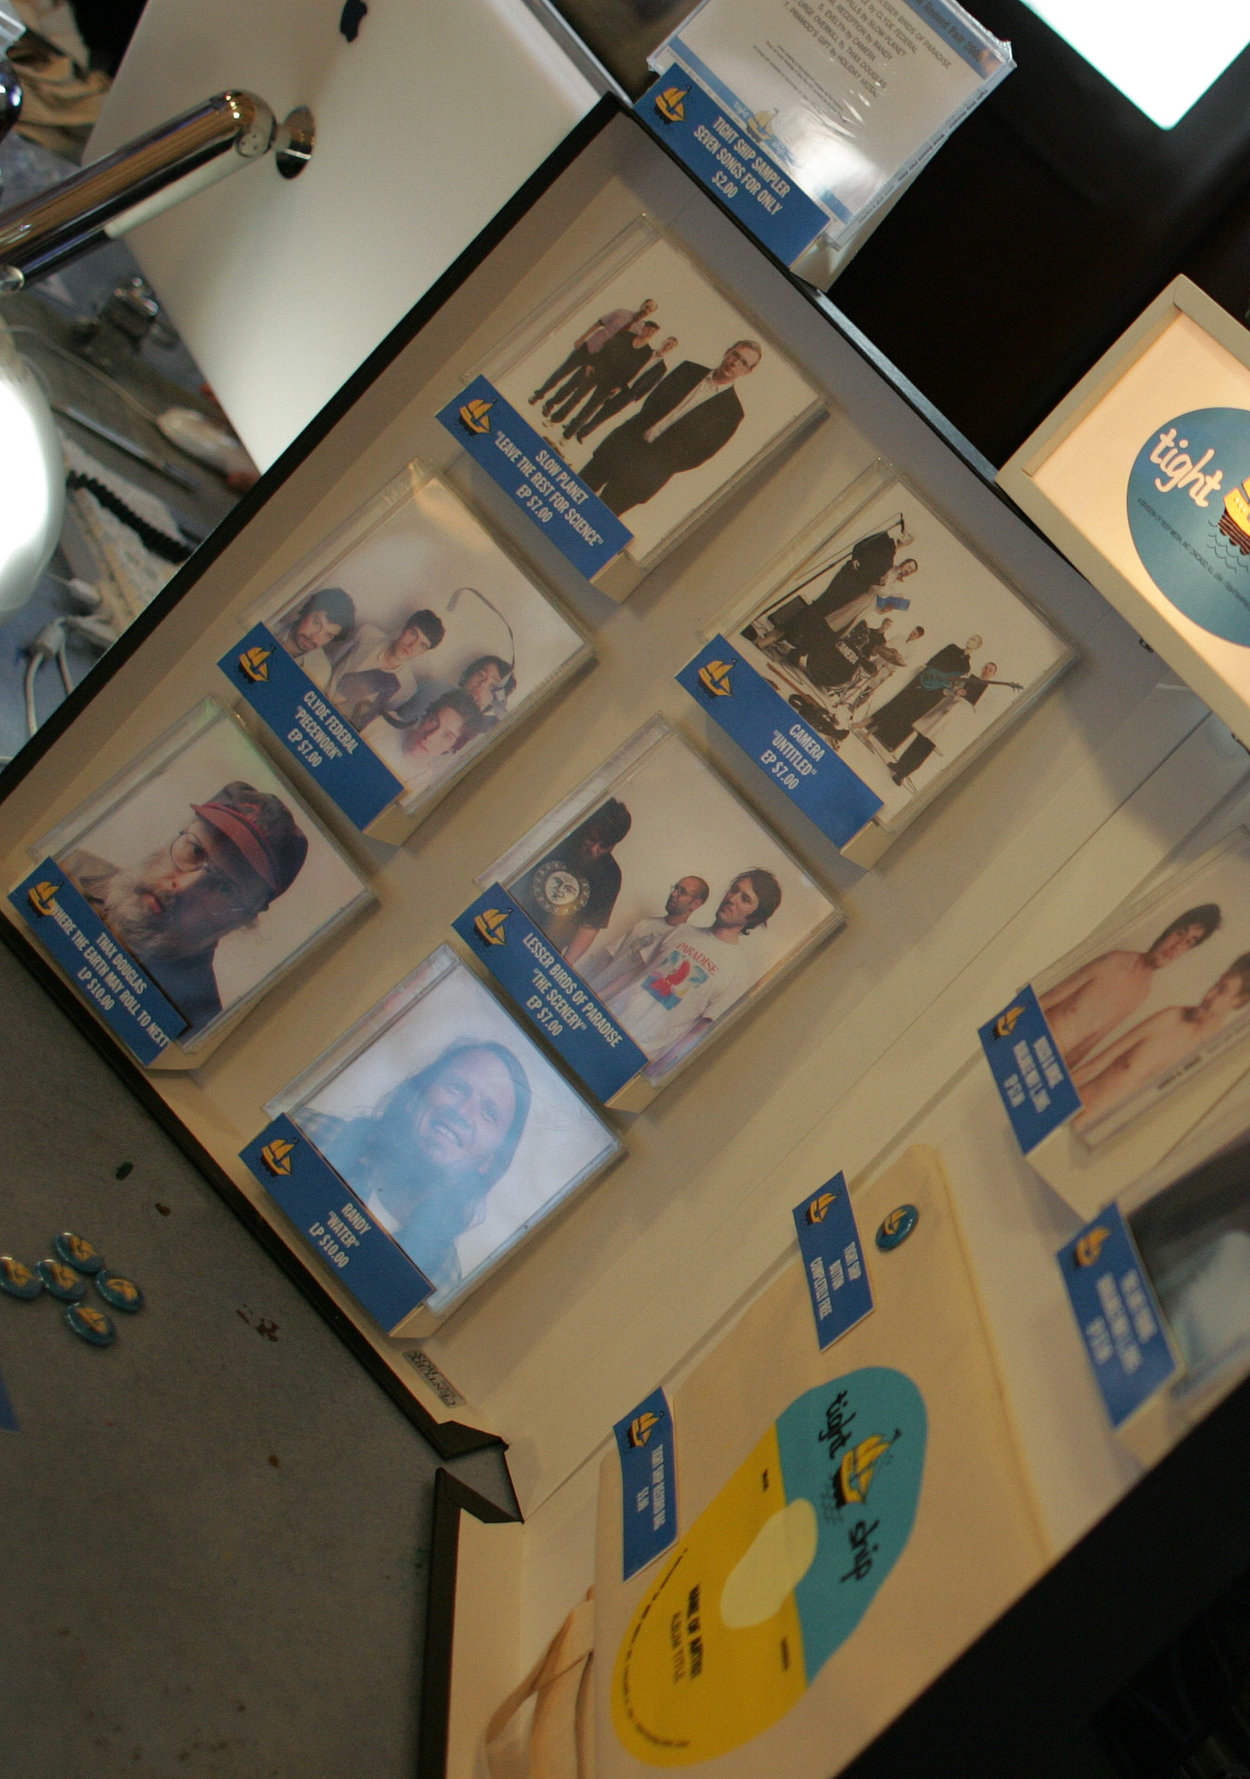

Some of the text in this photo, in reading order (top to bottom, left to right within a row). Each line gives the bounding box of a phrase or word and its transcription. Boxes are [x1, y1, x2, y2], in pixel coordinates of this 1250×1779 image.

[823, 9, 848, 32] EVELYN
[850, 35, 878, 61] CAMERA
[866, 19, 885, 38] SLOW
[882, 34, 906, 57] PLANET
[871, 39, 893, 61] RANDY
[692, 124, 722, 155] SEVEN
[714, 146, 747, 180] SONGS
[740, 172, 763, 196] FOR
[756, 188, 783, 217] ONLY
[710, 115, 740, 145] TIGHT
[731, 136, 758, 163] SHIP
[750, 155, 792, 199] SAMPLER
[709, 168, 740, 200] $2.00
[489, 430, 604, 550] "LEAVE THE REST FOR SCIENCE"
[533, 448, 589, 506] SLOW PLANET
[1149, 428, 1224, 507] tight
[514, 483, 555, 525] EP $7.00
[290, 704, 343, 763] "PIECEWORK"
[301, 689, 361, 755] CLYDE FEDERAL
[787, 721, 827, 762] CAMERA
[286, 727, 324, 768] EP $7.00
[759, 748, 801, 791] EP $7.00
[767, 728, 818, 781] "UNTITLED"
[68, 928, 91, 952] THE
[81, 944, 111, 977] EARTH
[102, 969, 126, 994] MAY
[117, 988, 143, 1016] ROLL
[134, 1009, 153, 1027] TO
[93, 931, 149, 995] THAX DOUGLAS
[674, 941, 721, 978] PARADISE
[75, 965, 116, 1012] LP $10.00
[521, 931, 623, 1048] LESSER BIRDS OF PARADISE
[526, 967, 588, 1036] "THE SCENERY"
[524, 994, 565, 1037] EP $7.00
[321, 1209, 361, 1252] "WATER"
[339, 1202, 372, 1236] RANDY
[307, 1221, 351, 1269] LP $10.00
[842, 1240, 862, 1284] TIGHT SHIP
[809, 1254, 832, 1321] COMPLETELY FREE
[827, 1257, 845, 1292] BUTTON
[651, 1442, 663, 1470] TIGHT
[652, 1462, 664, 1488] SHIP
[818, 1390, 880, 1583] tight ship
[688, 1616, 700, 1635] OF
